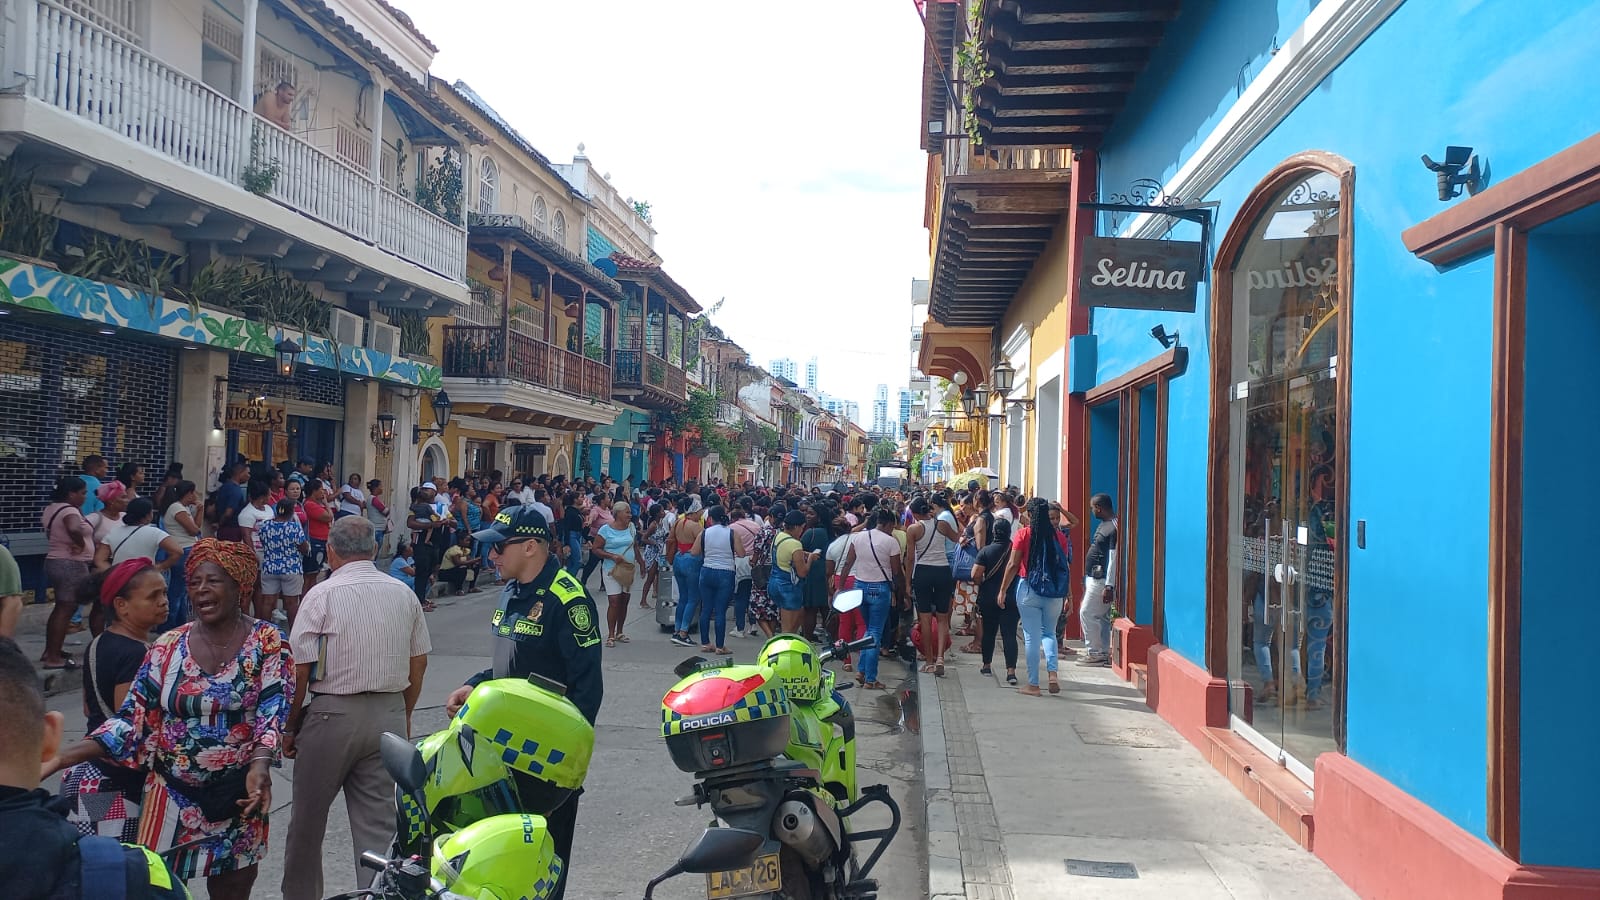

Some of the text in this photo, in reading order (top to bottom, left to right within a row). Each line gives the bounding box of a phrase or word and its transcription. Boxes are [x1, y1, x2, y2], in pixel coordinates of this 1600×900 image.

[1091, 258, 1186, 291] Selina
[226, 407, 284, 425] NICOLAS
[779, 675, 809, 684] OLICÍA
[682, 714, 734, 731] POLICÍA
